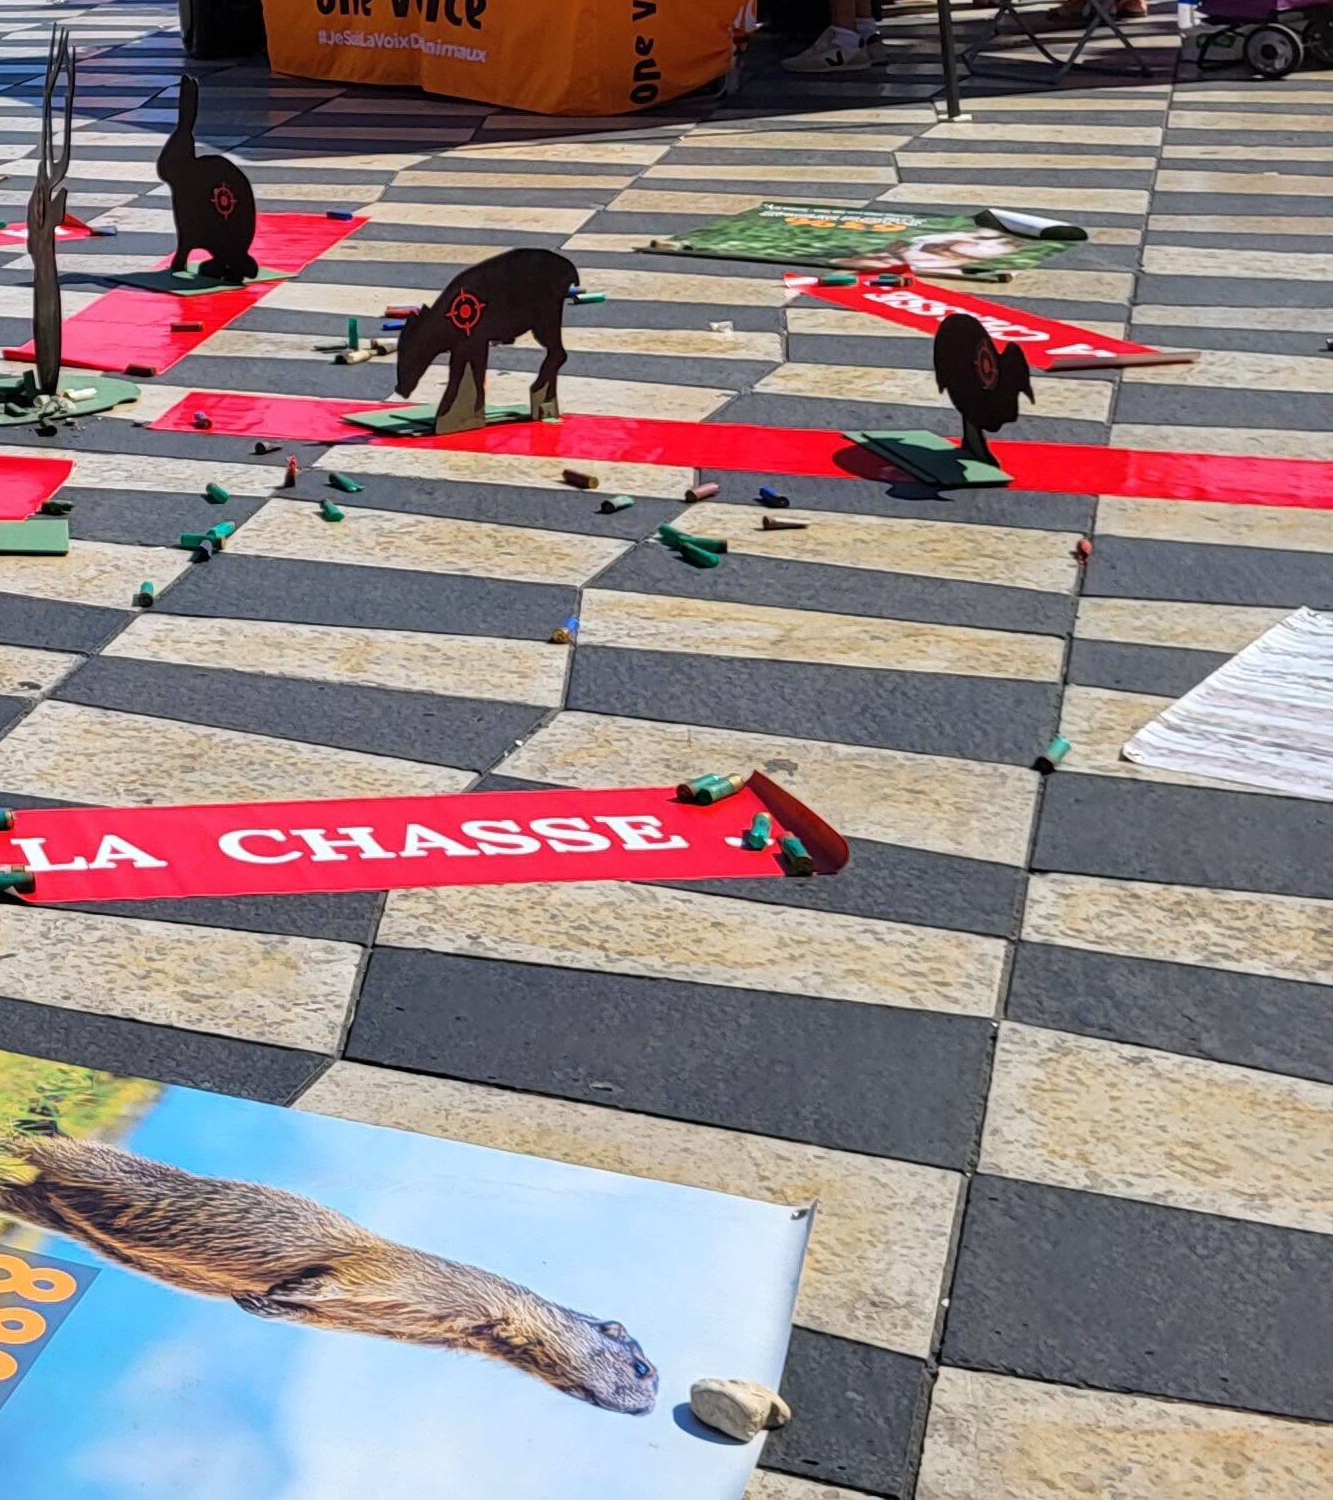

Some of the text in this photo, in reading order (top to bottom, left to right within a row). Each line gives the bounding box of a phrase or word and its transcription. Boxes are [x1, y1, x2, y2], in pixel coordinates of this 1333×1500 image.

[630, 37, 661, 105] one
[10, 815, 690, 873] LA CHASSE
